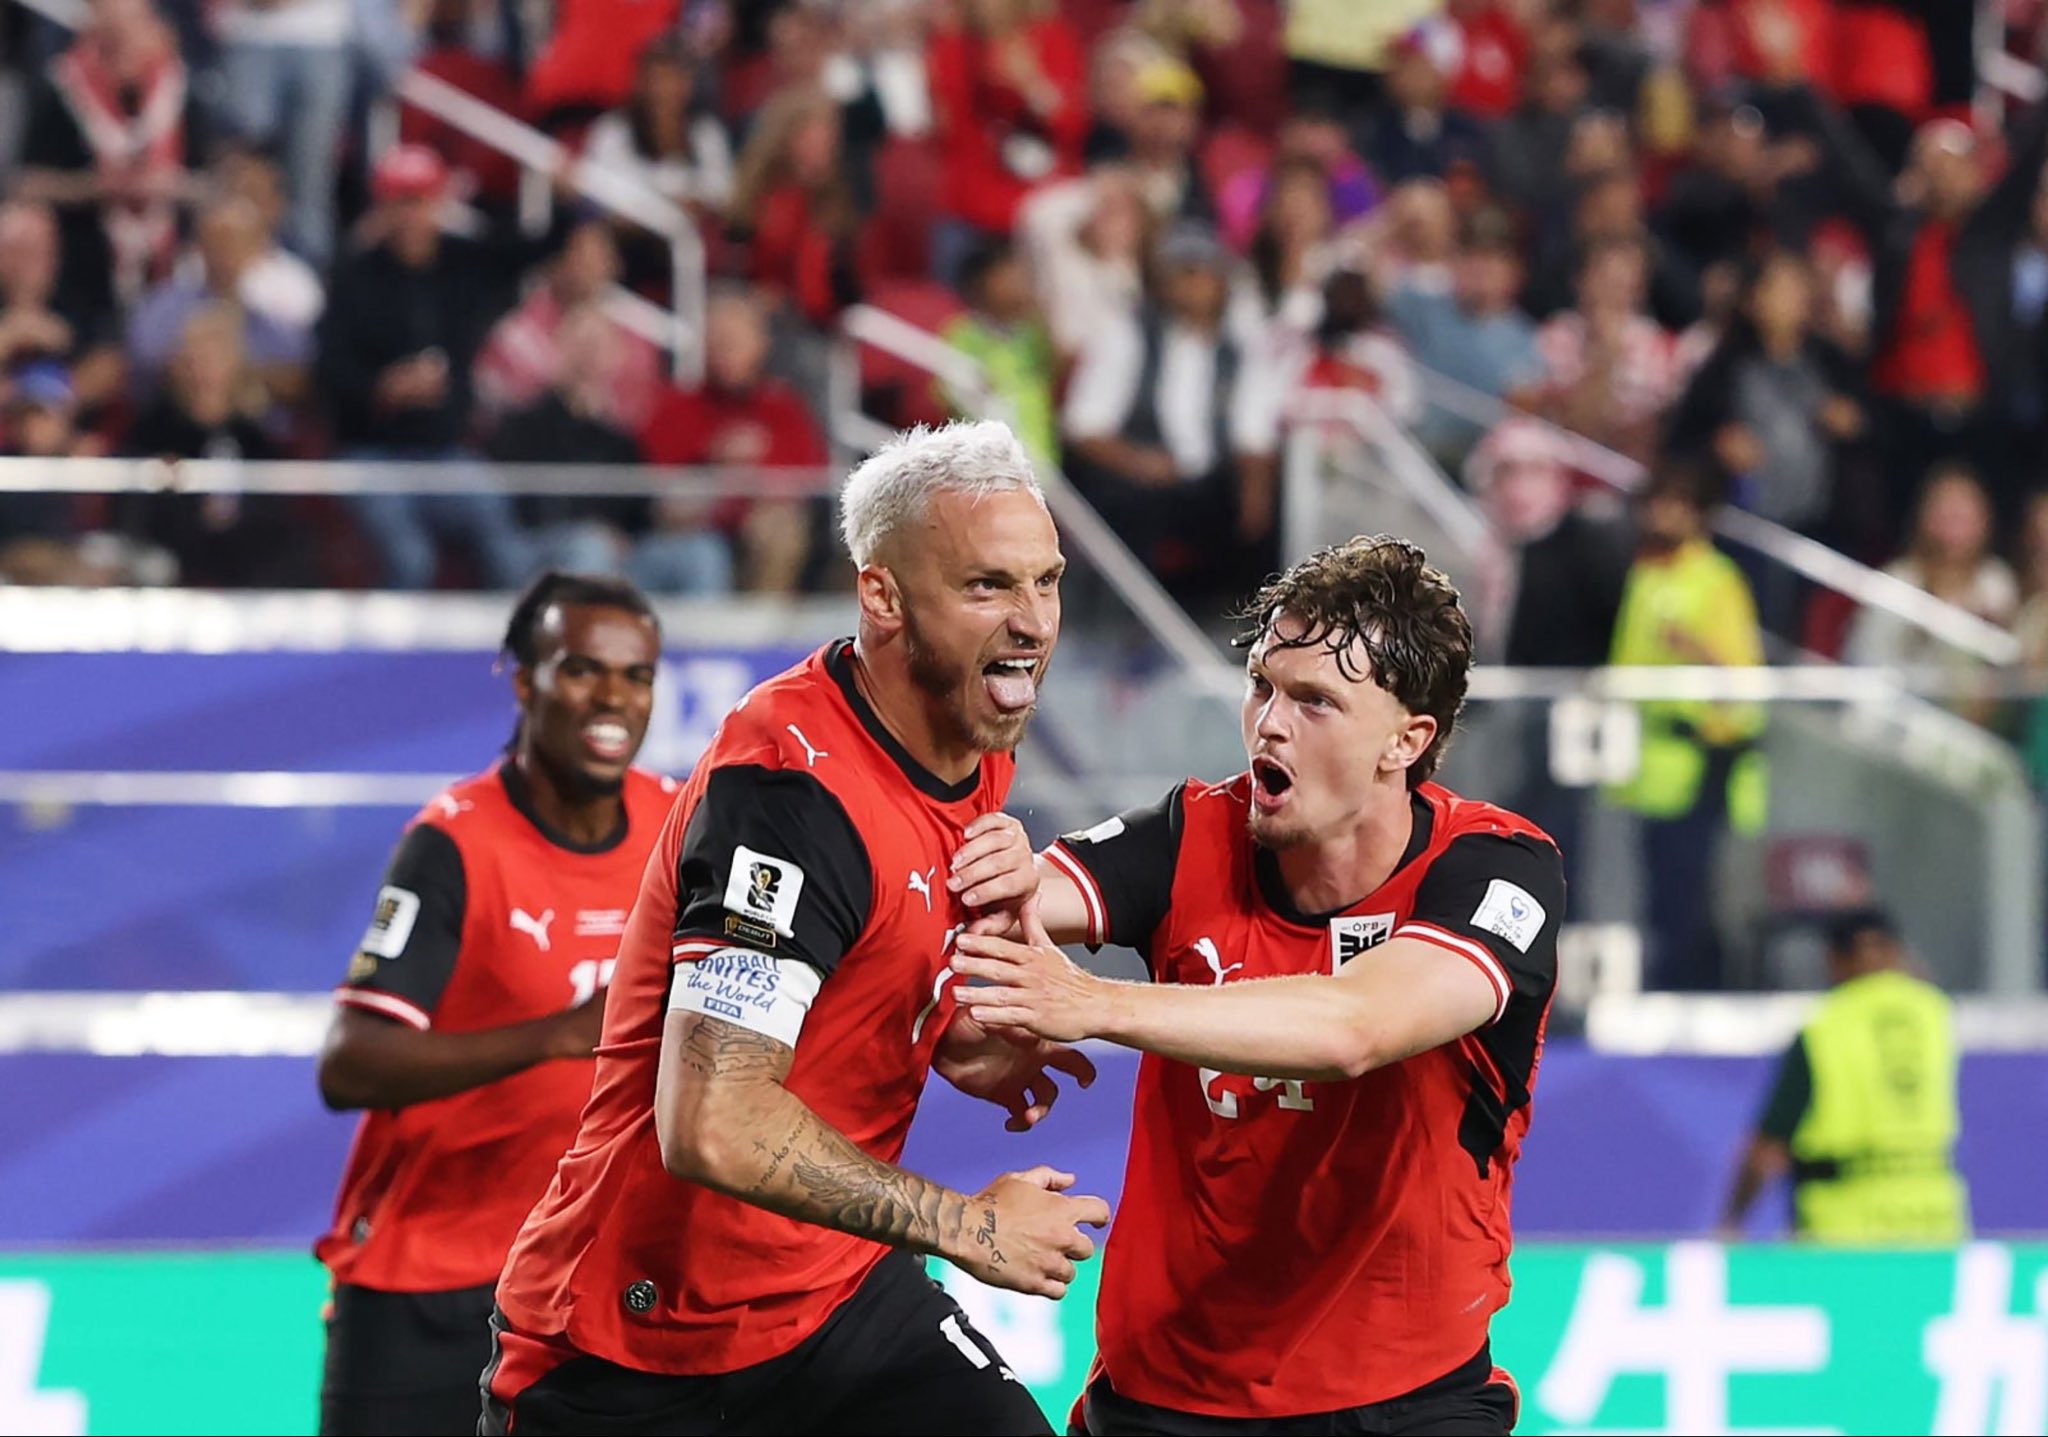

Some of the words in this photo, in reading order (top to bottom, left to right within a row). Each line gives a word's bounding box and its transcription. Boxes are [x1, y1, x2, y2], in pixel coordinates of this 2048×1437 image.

[704, 954, 781, 975] OOTBALL
[687, 972, 713, 991] the
[716, 980, 777, 1013] World
[705, 997, 741, 1018] FIFA
